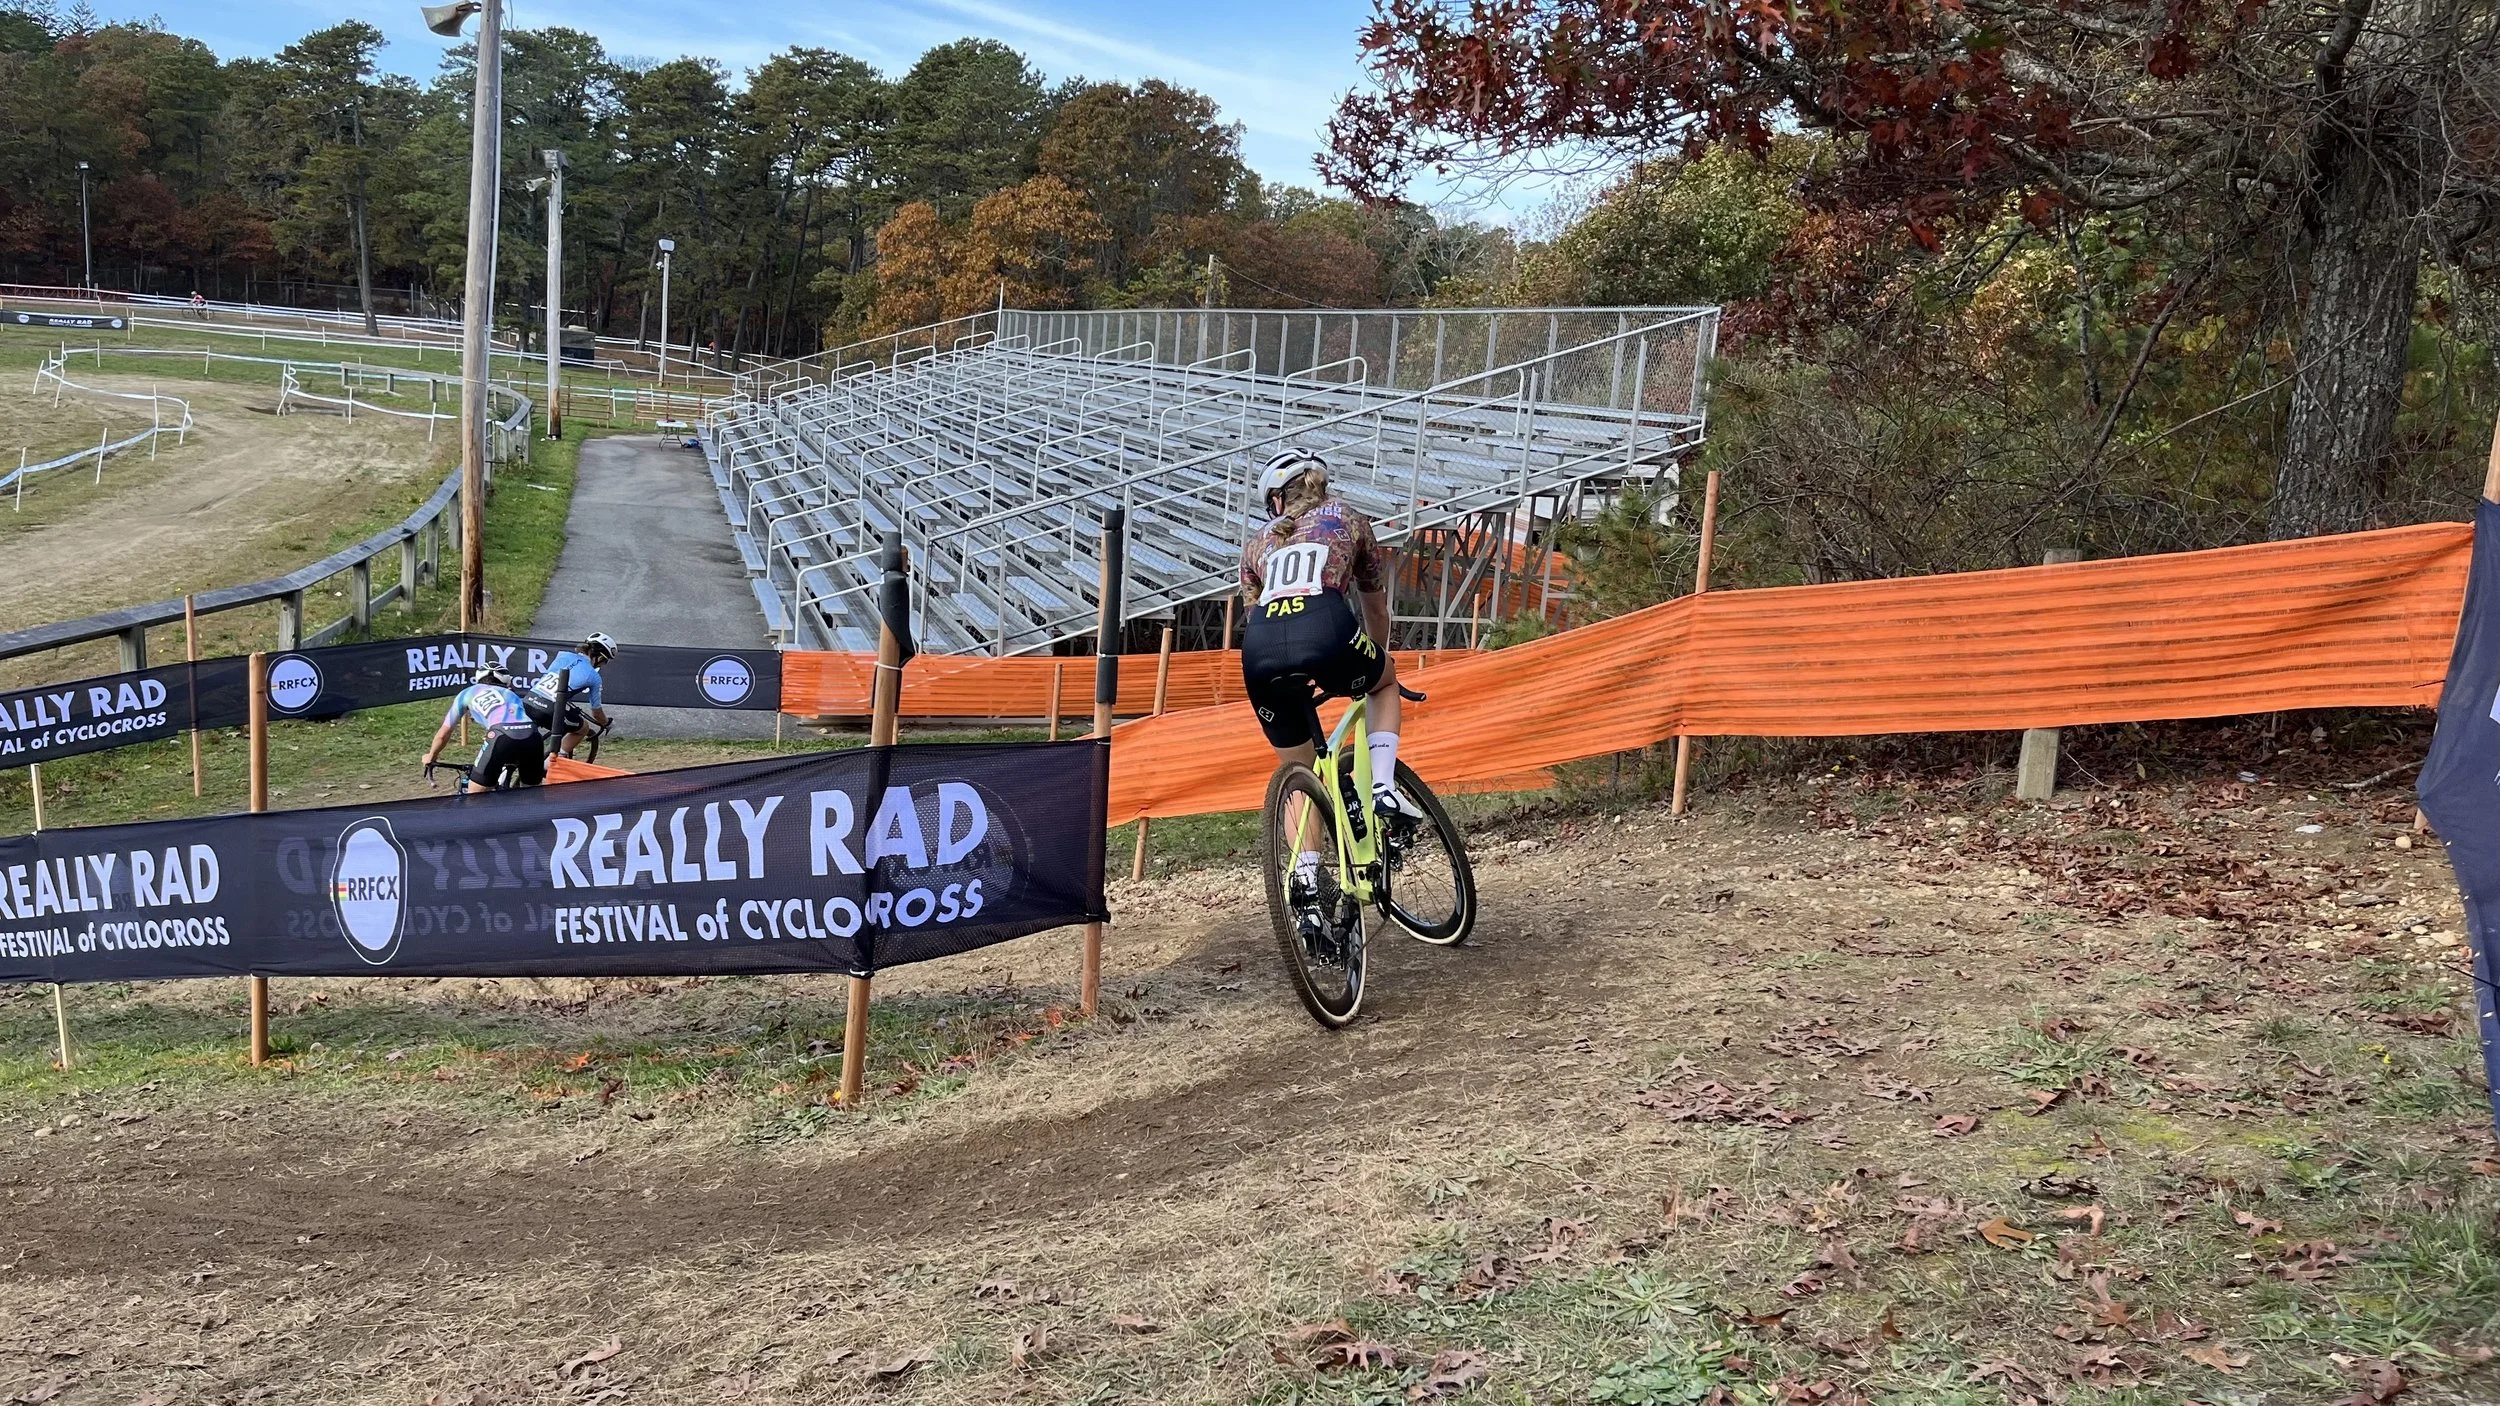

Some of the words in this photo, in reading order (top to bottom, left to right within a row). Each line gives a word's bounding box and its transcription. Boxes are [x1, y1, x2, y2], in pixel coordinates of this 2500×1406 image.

[1268, 550, 1317, 591] 101
[1266, 596, 1305, 618] PAS
[406, 643, 516, 674] REALLY
[278, 676, 318, 691] RRFCX
[409, 673, 468, 692] FESTIVAL
[539, 673, 560, 691] 25
[710, 675, 748, 686] RRFCX
[0, 690, 75, 733] ALLY
[88, 679, 167, 718] RAD
[31, 731, 50, 750] of
[55, 711, 167, 745] CYCLOCROSS
[550, 795, 785, 889] REALLY
[809, 782, 989, 876] RAD
[130, 844, 220, 908] RAD
[348, 875, 399, 902] RRFCX
[555, 904, 689, 944] FESTIVAL
[696, 897, 730, 942] of
[738, 878, 984, 940] CYCLOCROSS
[0, 927, 75, 959] FESTIVAL
[78, 922, 97, 953] of
[100, 916, 231, 951] CYCLOCROSS
